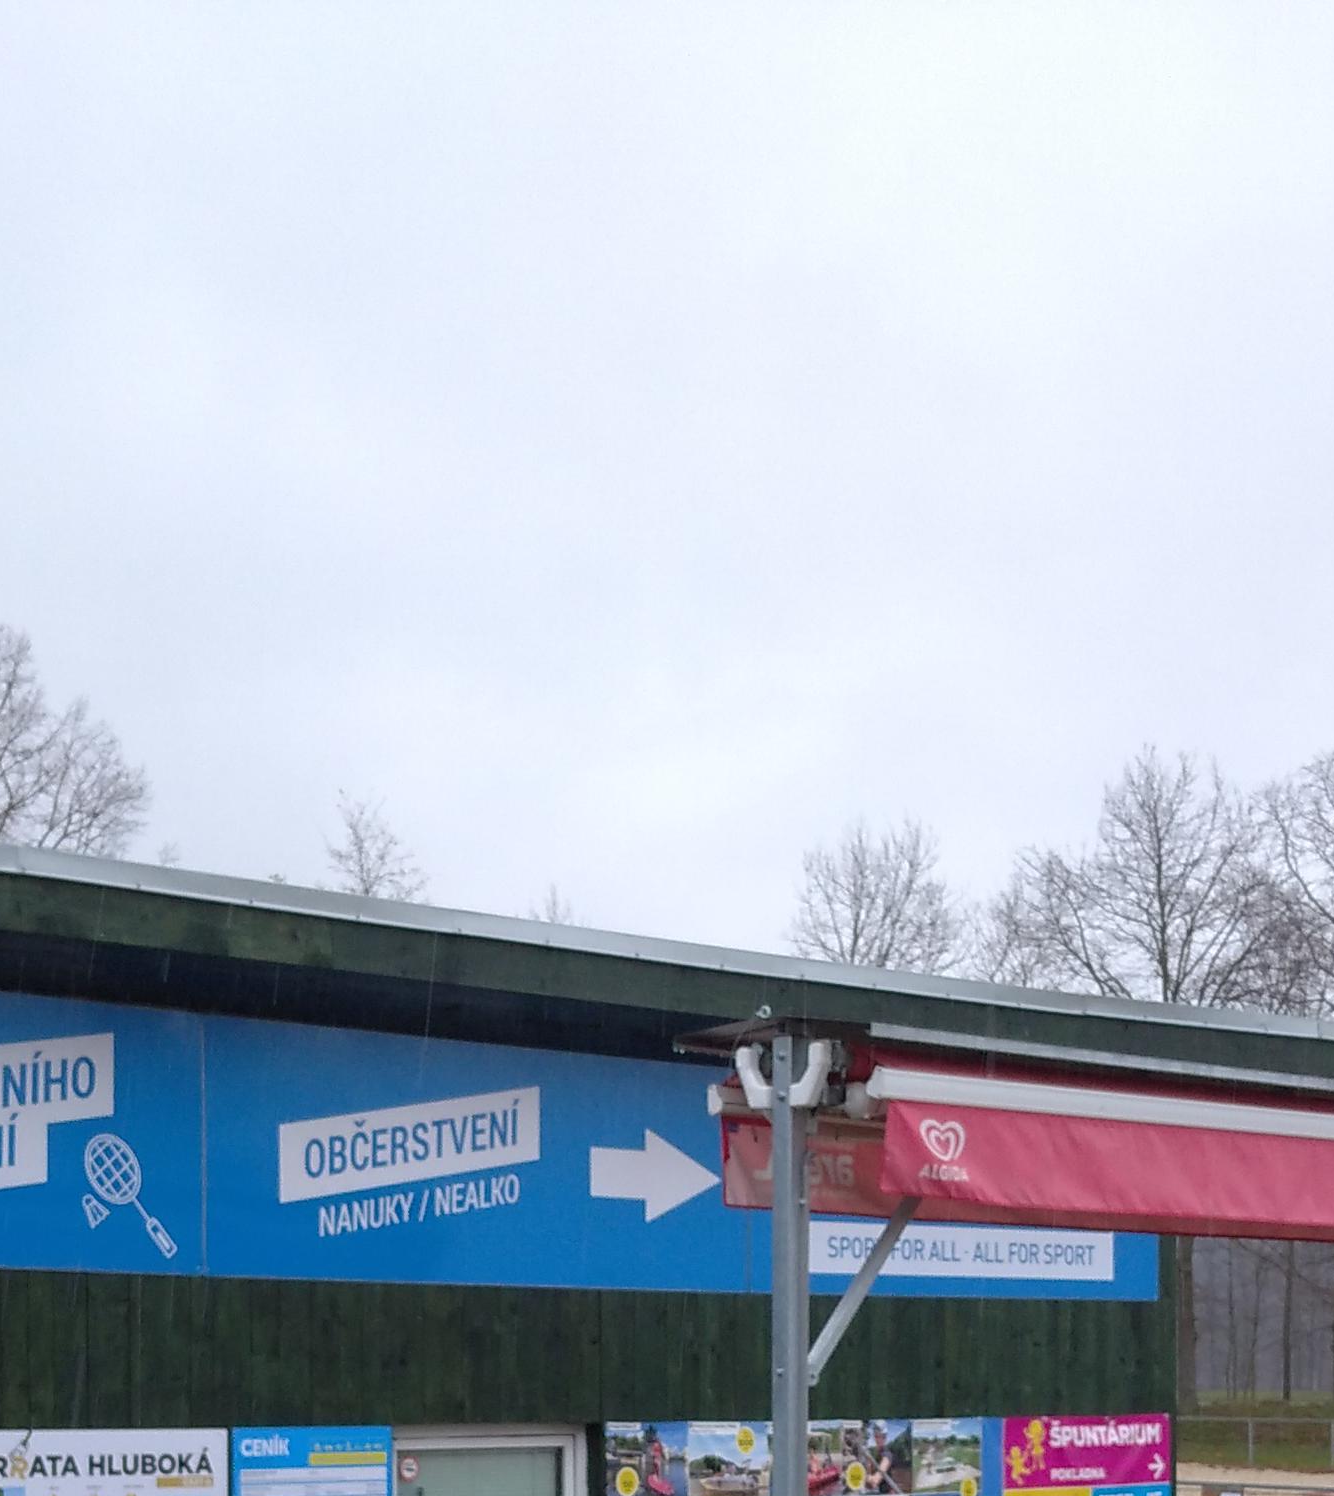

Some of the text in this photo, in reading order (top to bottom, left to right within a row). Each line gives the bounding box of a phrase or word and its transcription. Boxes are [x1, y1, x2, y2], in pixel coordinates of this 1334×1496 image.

[304, 1099, 519, 1179] OBČERSTVENÍ
[318, 1197, 414, 1237] NANUKY
[434, 1175, 520, 1217] NEALKO
[827, 1236, 879, 1259] SPOR
[928, 1240, 961, 1262] ALL
[973, 1241, 1004, 1263] ALL
[1008, 1242, 1040, 1264] FOR
[1043, 1244, 1095, 1266] SPORT
[241, 1434, 290, 1457] CENÍK
[1049, 1420, 1162, 1448] ŠPUNTÁRIUM
[88, 1447, 214, 1477] HLUBOKÁ
[1049, 1467, 1106, 1480] POKLADNA
